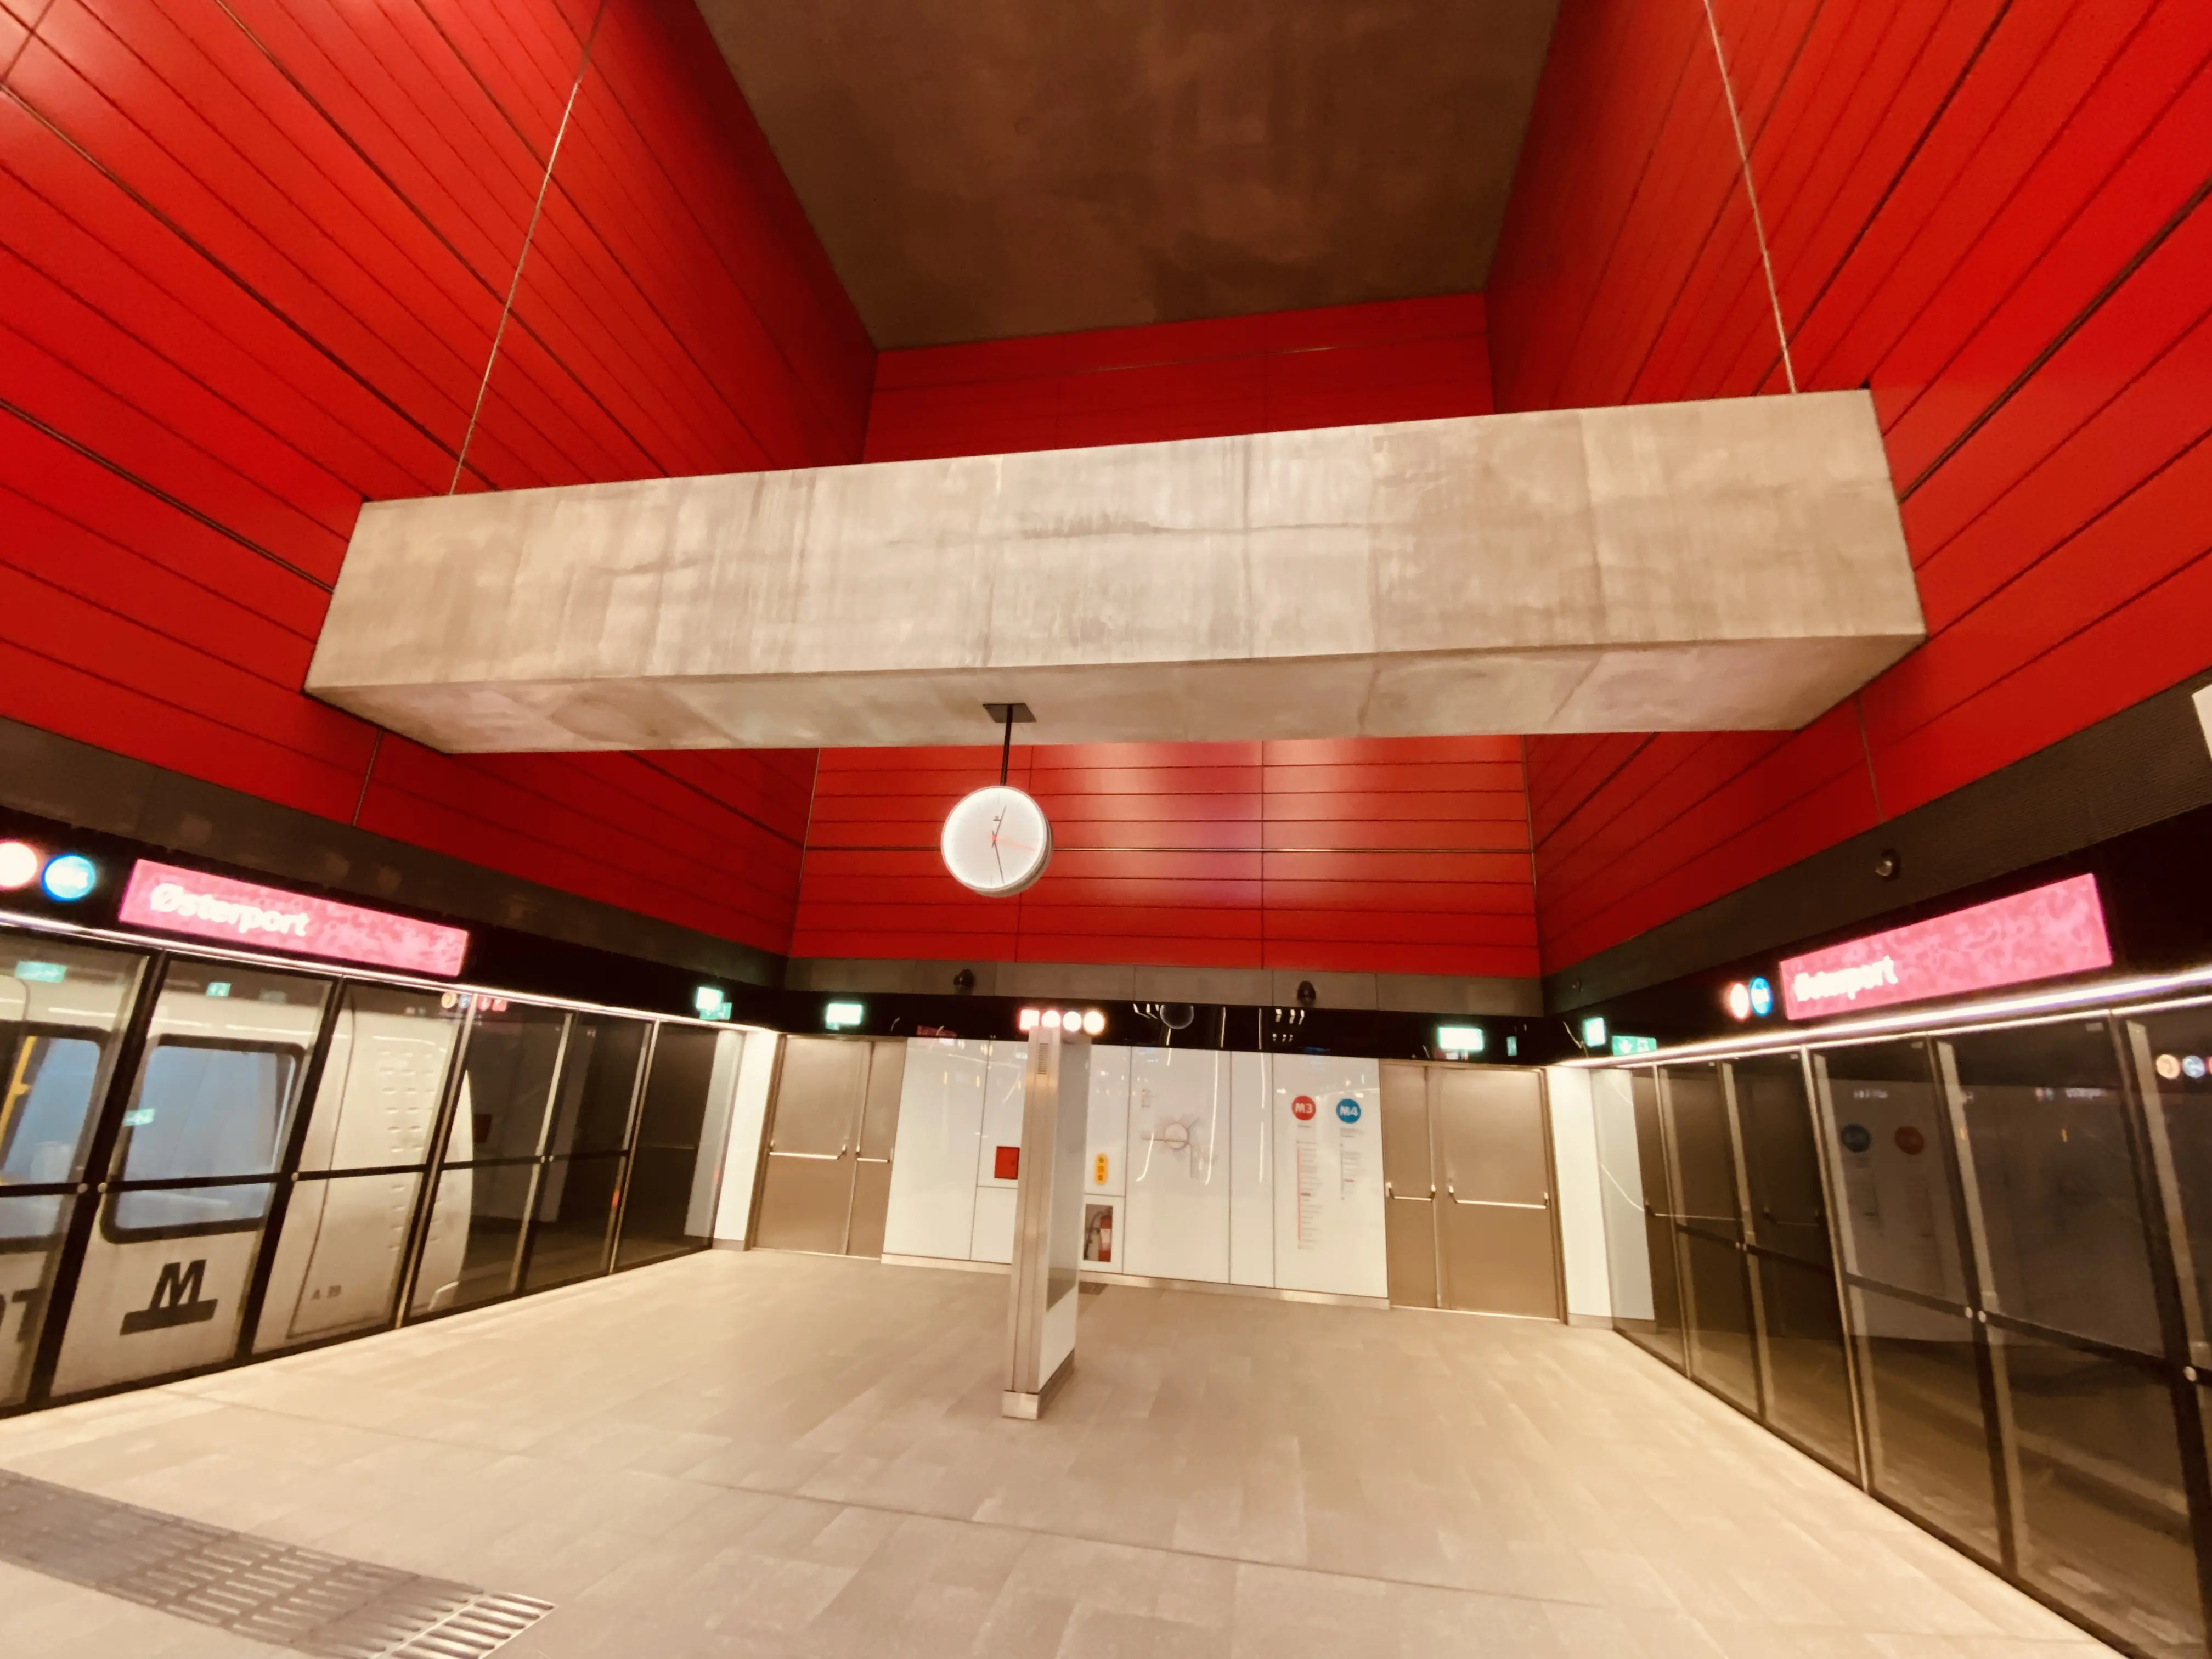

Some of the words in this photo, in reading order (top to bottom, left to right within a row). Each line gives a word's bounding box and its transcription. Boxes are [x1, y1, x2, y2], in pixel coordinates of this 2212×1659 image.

[150, 883, 309, 936] Østerport
[1295, 1103, 1313, 1114] M3
[1340, 1105, 1358, 1116] M4
